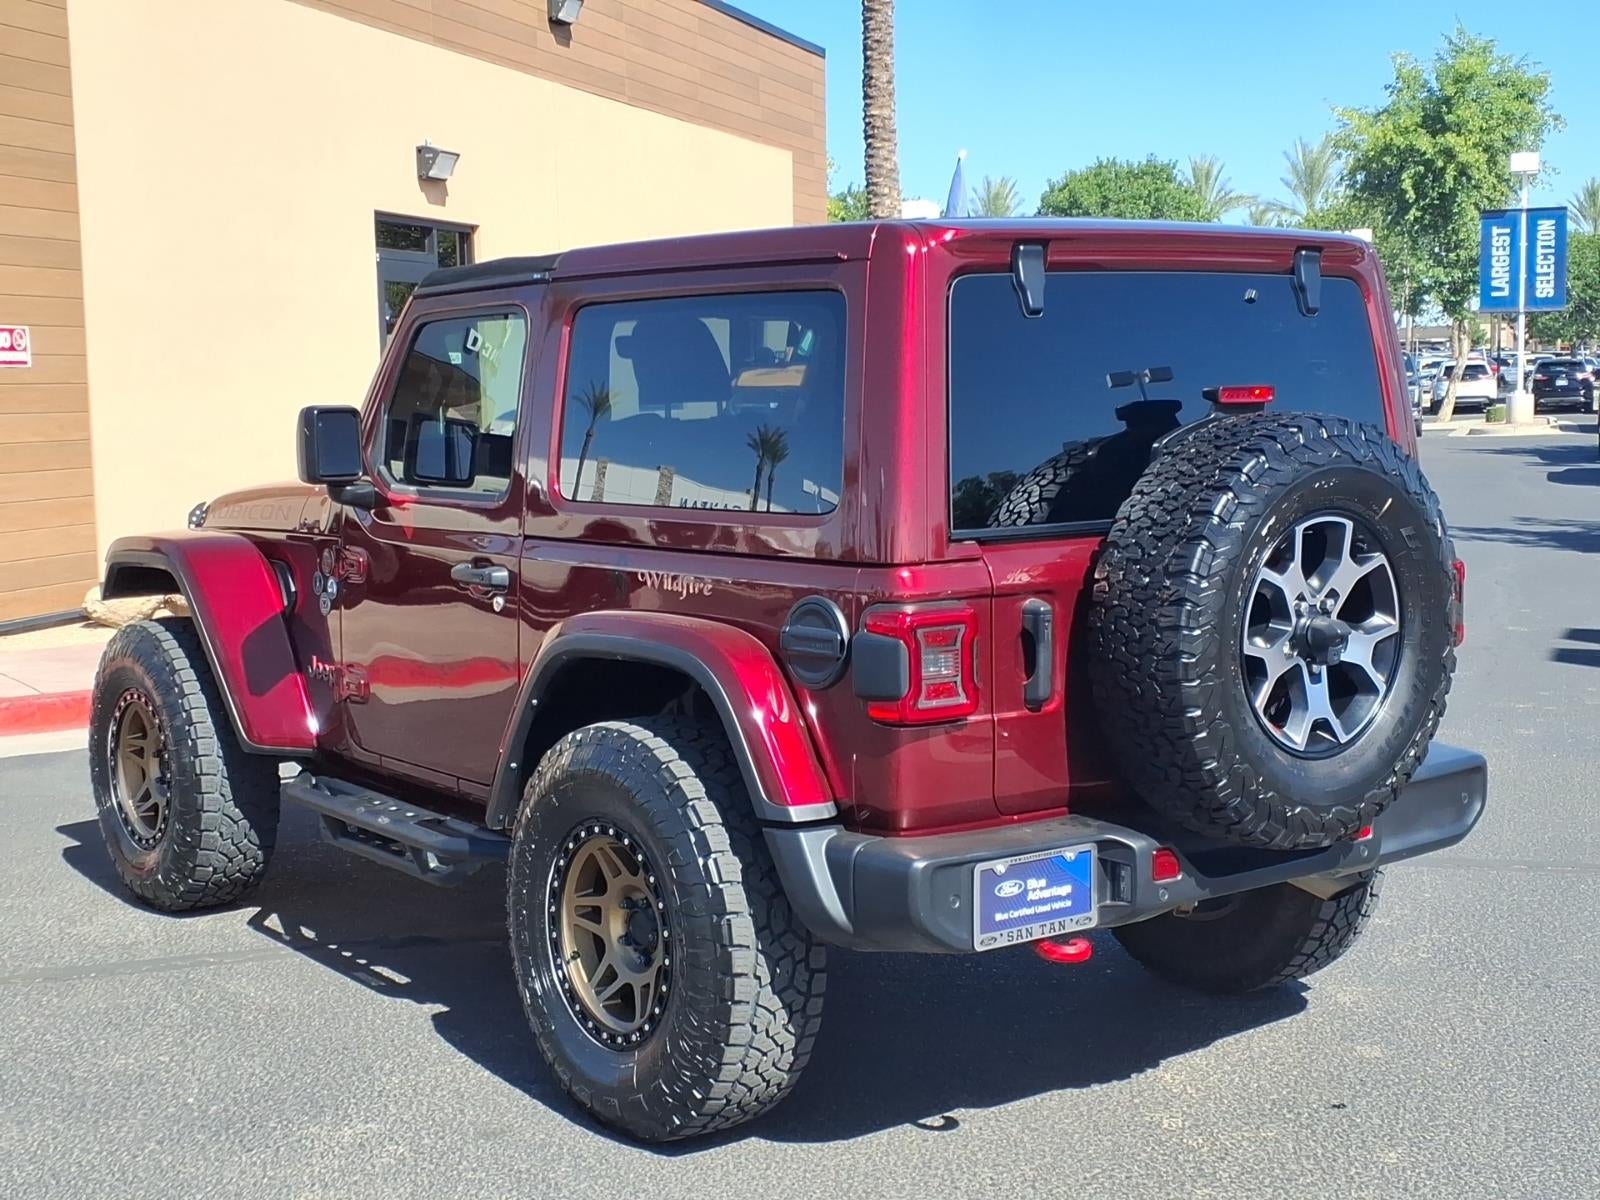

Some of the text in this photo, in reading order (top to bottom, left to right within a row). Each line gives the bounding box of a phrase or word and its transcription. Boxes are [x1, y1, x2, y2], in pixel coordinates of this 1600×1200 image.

[1491, 226, 1511, 297] LARGEST
[1535, 219, 1556, 298] SELECTION
[638, 571, 713, 600] Wildfire
[1026, 878, 1047, 890] Blue
[1027, 884, 1072, 902] Advantage
[1006, 927, 1034, 943] SAN
[1039, 919, 1066, 936] TAN
